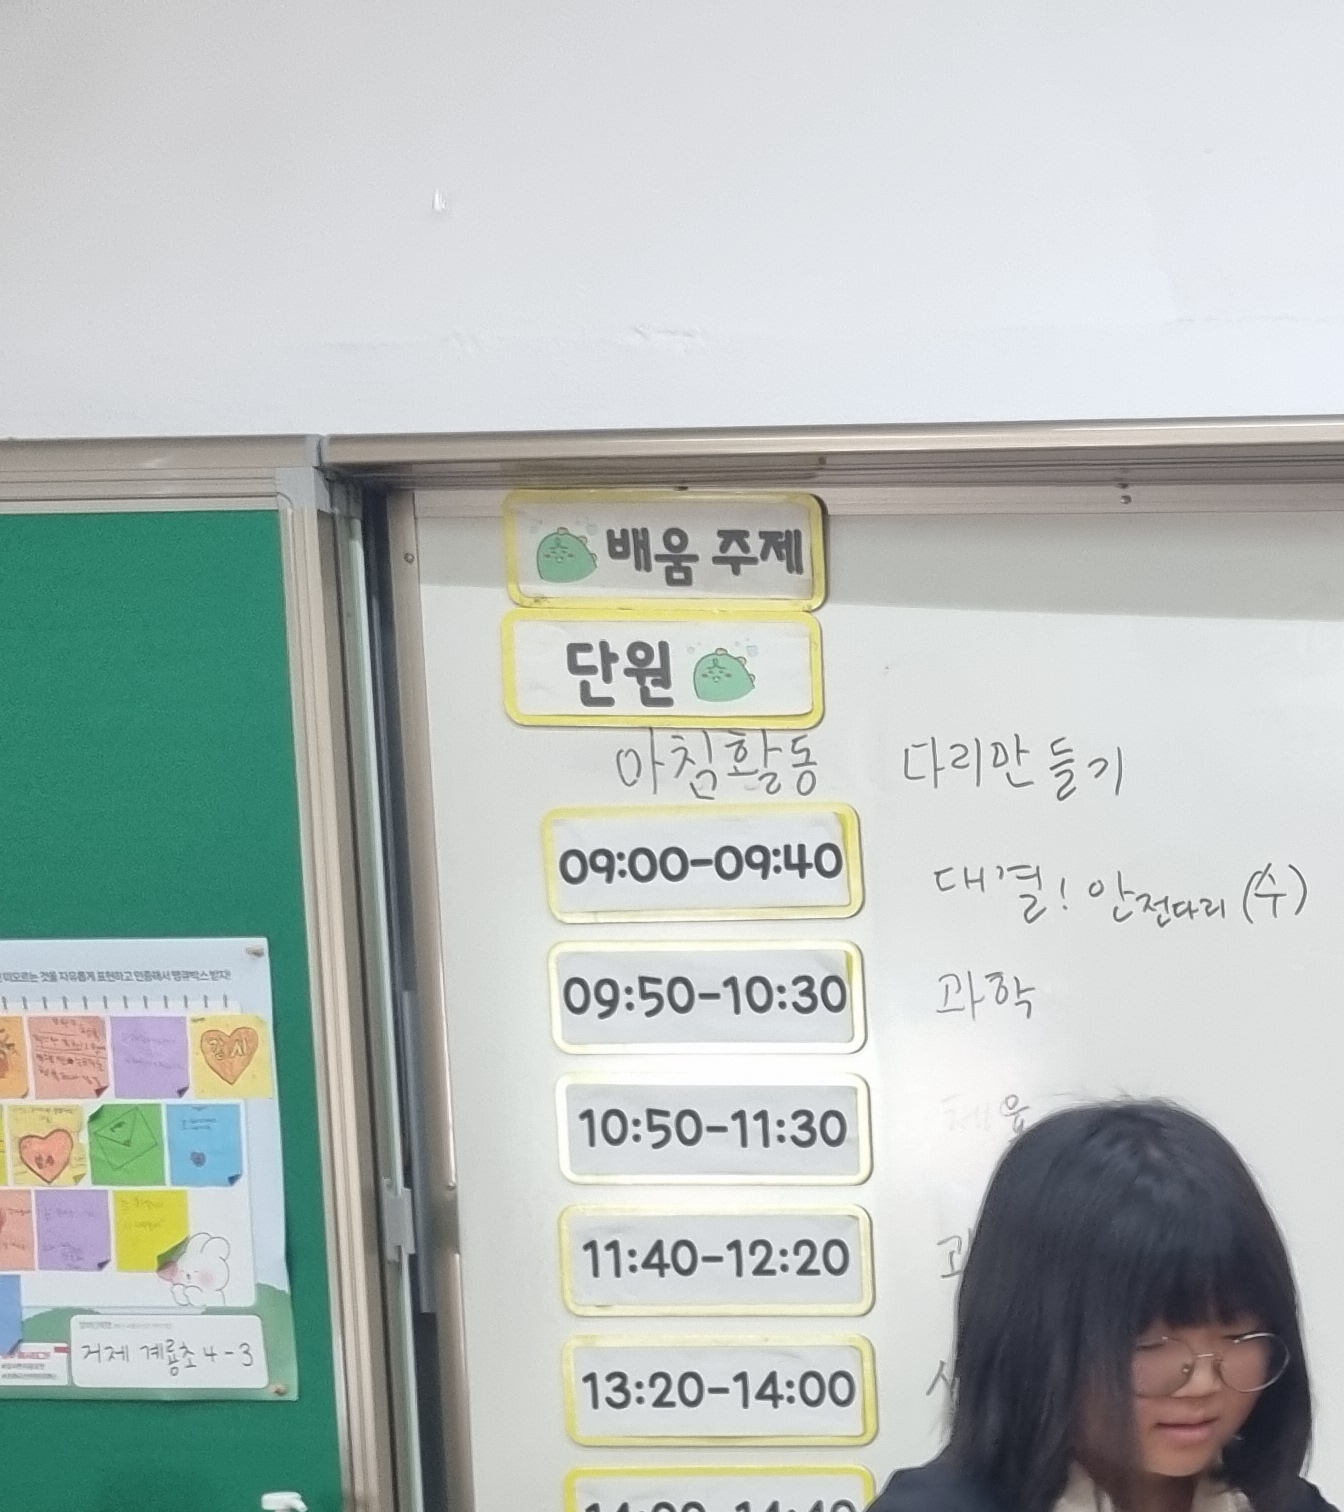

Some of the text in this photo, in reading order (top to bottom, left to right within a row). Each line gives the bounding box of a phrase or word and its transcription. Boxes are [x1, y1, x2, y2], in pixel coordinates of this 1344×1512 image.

[607, 526, 803, 587] 배움 주제
[567, 640, 675, 708] 단원
[616, 728, 819, 800] 아침활동
[558, 842, 843, 887] 09:00-09:40
[562, 975, 848, 1018] 09:50-10:30
[935, 971, 1038, 1022] 과학
[577, 1107, 848, 1149] 10:50-11:30
[581, 1238, 851, 1279] 11:40-12:20
[80, 1343, 131, 1364] 거제
[581, 1369, 857, 1411] 13:20-14:00
